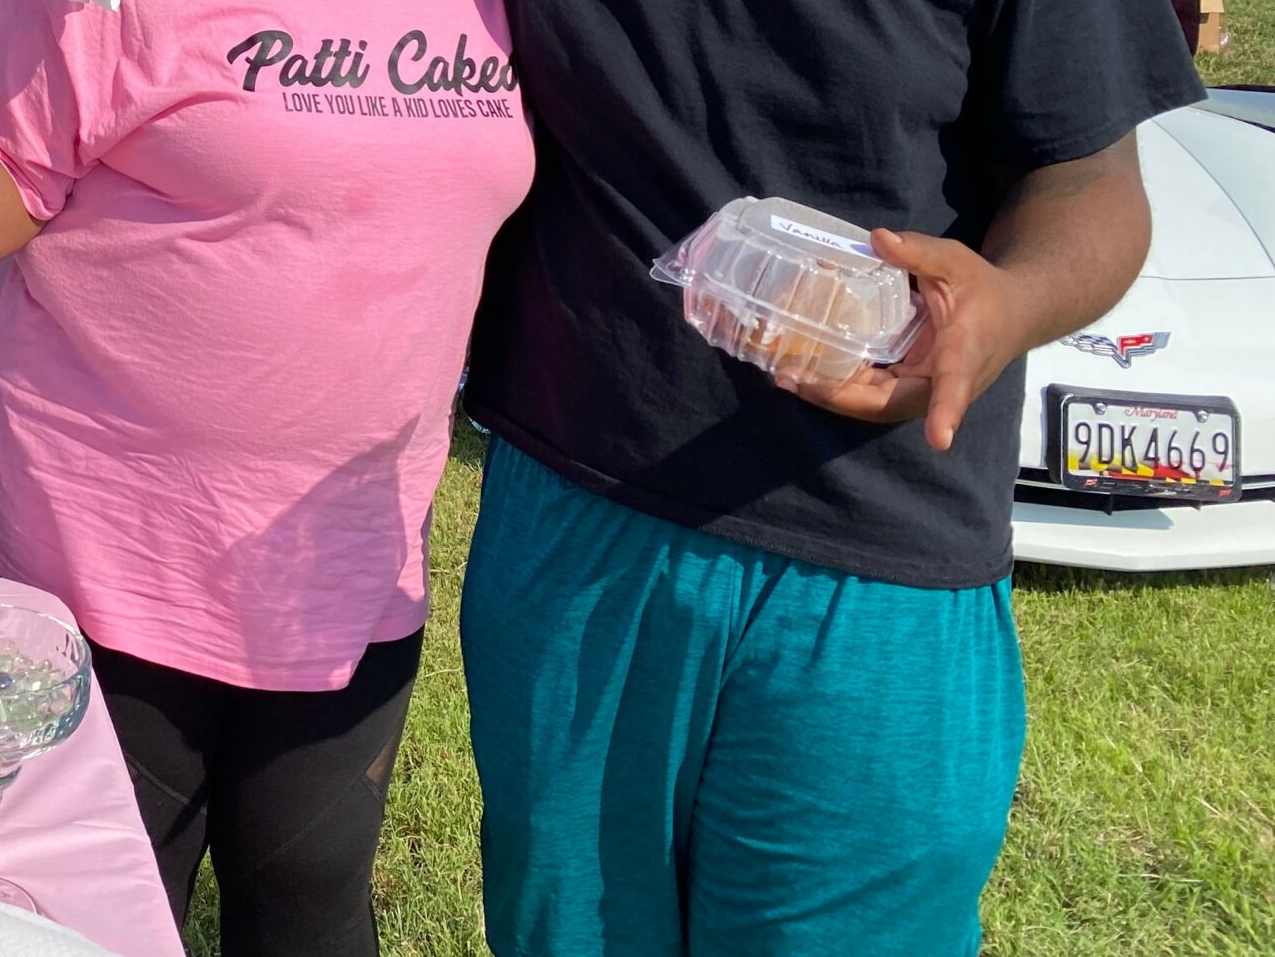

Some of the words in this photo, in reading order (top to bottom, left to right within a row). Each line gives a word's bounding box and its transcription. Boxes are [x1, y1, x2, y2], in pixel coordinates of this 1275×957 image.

[227, 30, 370, 92] Patti
[388, 30, 519, 96] Cakes
[282, 92, 323, 114] LOVE
[326, 96, 355, 115] YOU
[359, 96, 388, 117] LIKE
[392, 97, 403, 117] A
[406, 98, 429, 118] KID
[430, 98, 476, 118] LOVES
[476, 99, 513, 119] CAKE
[1124, 406, 1178, 421] Maryland
[1075, 422, 1229, 473] 9DK4669
